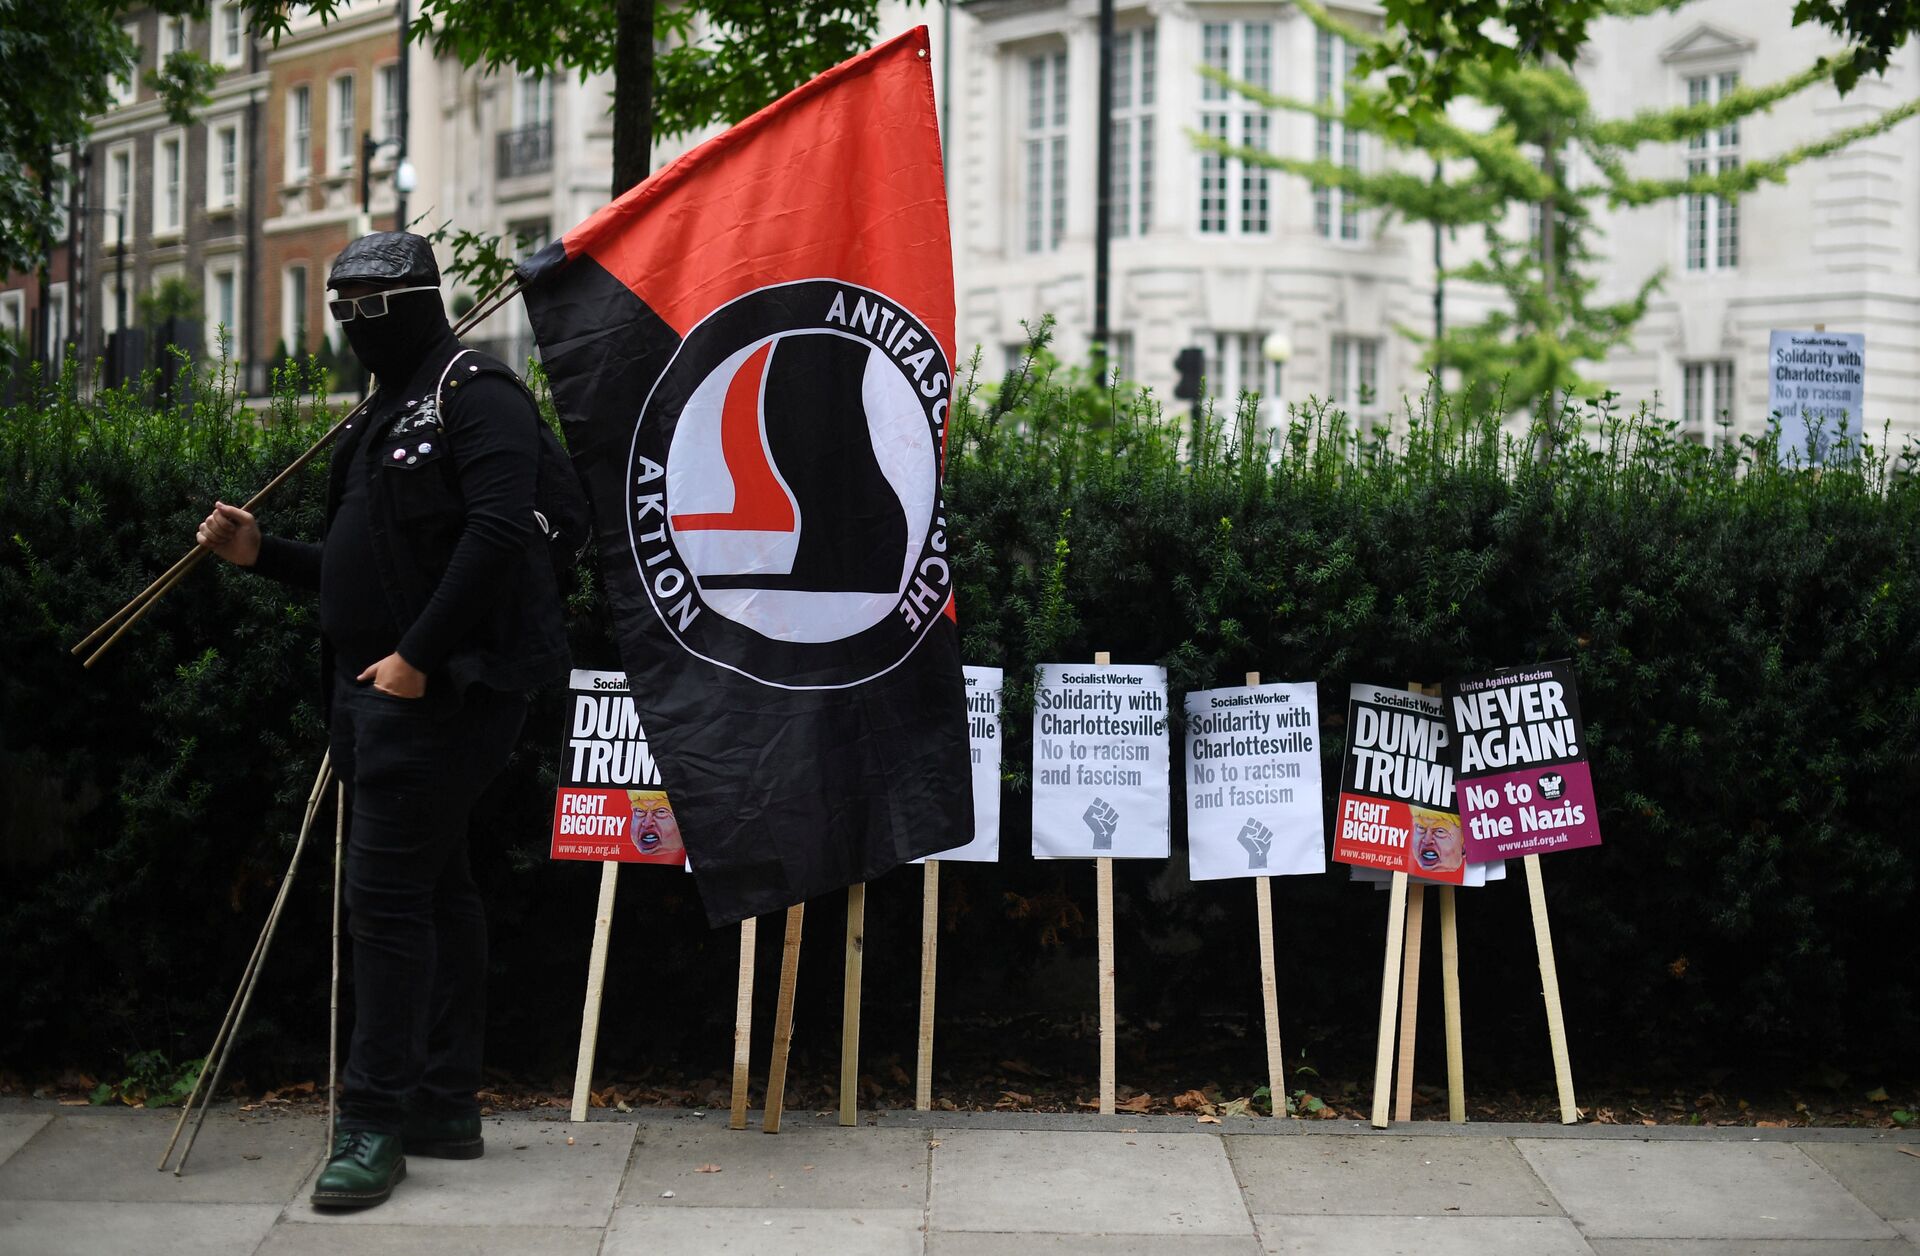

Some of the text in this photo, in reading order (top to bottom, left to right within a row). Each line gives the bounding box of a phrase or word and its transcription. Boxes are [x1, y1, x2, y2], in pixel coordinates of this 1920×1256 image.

[1776, 348, 1861, 368] Solidarity with
[1776, 366, 1861, 384] Charlottesville
[1776, 384, 1852, 401] No to racism
[825, 290, 950, 632] ANTIFASCSCHE
[637, 455, 701, 633] AKTION
[593, 677, 629, 690] Sociali
[1061, 673, 1144, 685] Socialist Worker
[1459, 670, 1553, 692] Unite Against Fascism
[1041, 688, 1162, 714] Solidarity with
[1211, 693, 1290, 708] Socialist Worker
[1373, 692, 1419, 710] Socialist
[1452, 681, 1568, 733] NEVER
[572, 695, 647, 740] DUM
[1040, 713, 1163, 737] Charlottesville
[1192, 707, 1311, 736] Solidarity with
[1192, 732, 1313, 760] Charlottesville
[1354, 706, 1450, 762] DUMP
[1461, 718, 1579, 773] AGAIN!
[569, 739, 662, 785] TRUM
[1041, 739, 1150, 761] No to racism
[1040, 764, 1142, 786] and fascism
[1194, 759, 1301, 785] No to racism
[561, 794, 607, 815] FIGHT
[1194, 784, 1294, 809] and fascism
[1465, 781, 1532, 812] No to
[1344, 799, 1390, 824] FIGHT
[1470, 799, 1586, 840] the Nazis
[560, 815, 627, 836] BIGOTRY
[1342, 820, 1409, 848] BIGOTRY
[558, 844, 620, 857] www.swp.org.uk
[1497, 832, 1568, 852] www.uaf.org.uk
[1340, 848, 1403, 866] www.swp.org.uk
